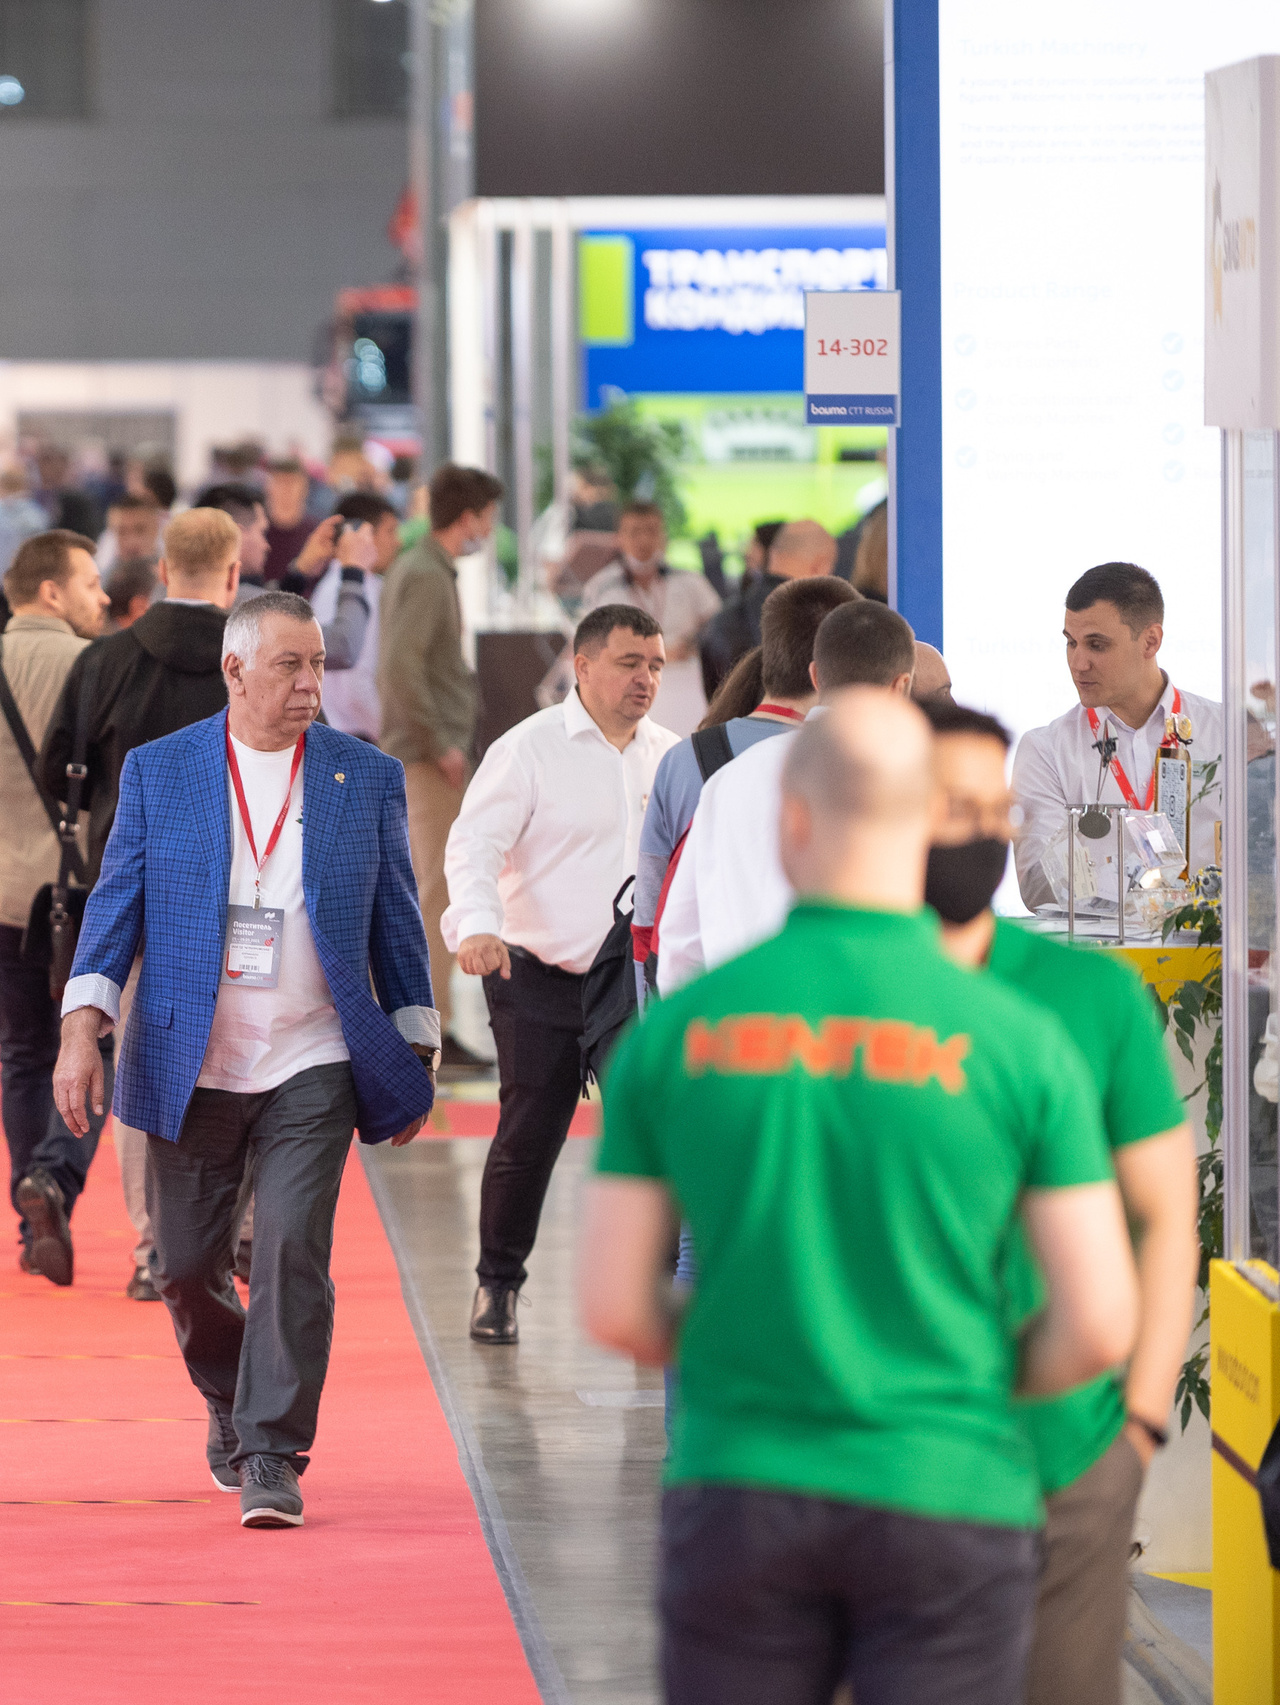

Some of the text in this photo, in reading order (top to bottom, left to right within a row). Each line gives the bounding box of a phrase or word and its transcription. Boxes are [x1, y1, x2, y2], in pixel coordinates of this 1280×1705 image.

[817, 338, 888, 356] 14-302
[811, 402, 894, 415] bauma CTT RUSSIA
[233, 920, 272, 931] Посетитель
[233, 928, 255, 936] Visitor
